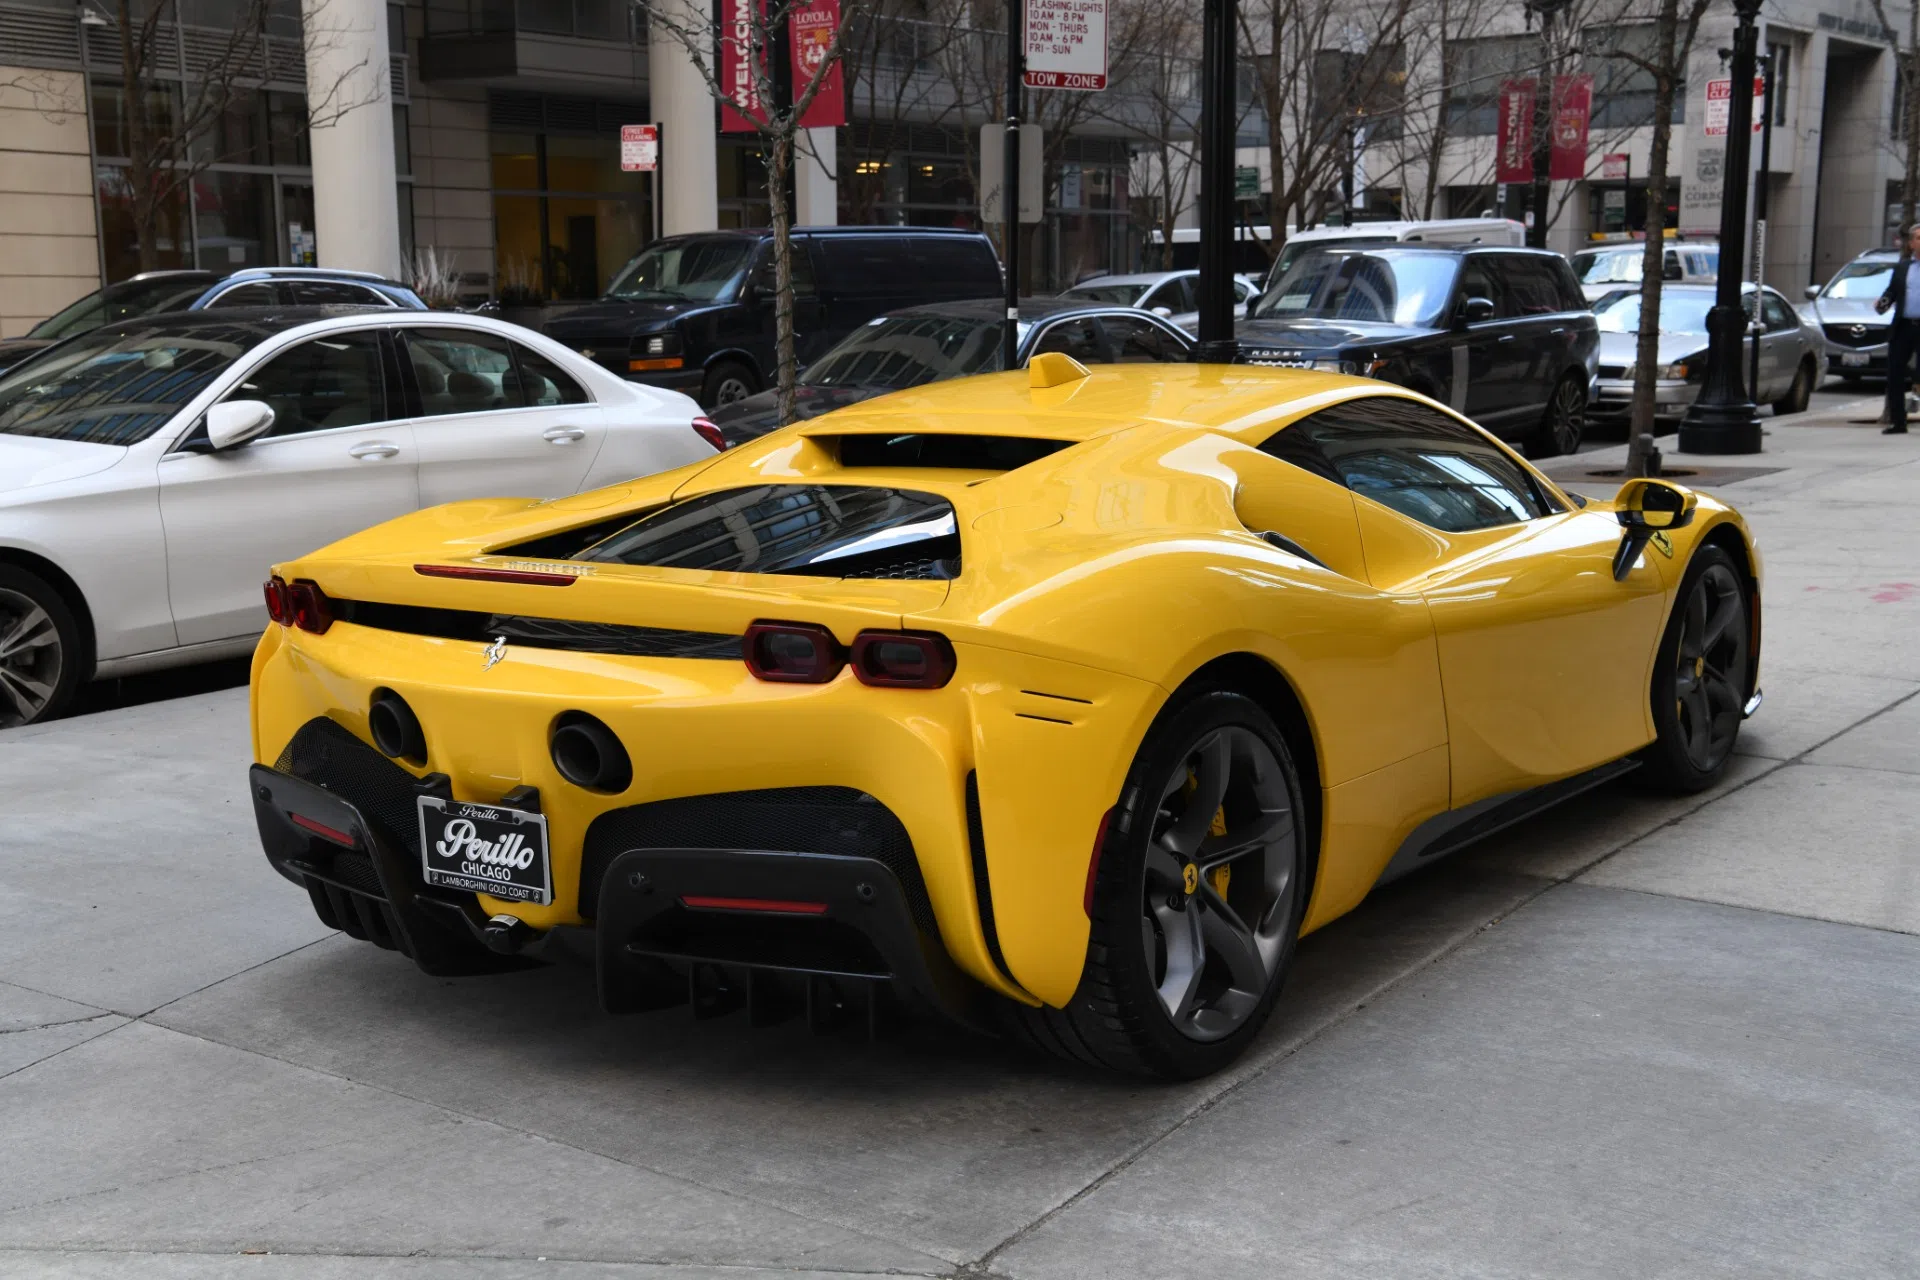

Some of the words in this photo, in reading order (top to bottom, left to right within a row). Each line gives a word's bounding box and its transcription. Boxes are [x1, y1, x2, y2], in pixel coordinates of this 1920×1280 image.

[1029, 0, 1072, 11] FLASHING
[1074, 3, 1103, 13] LIGHTS
[796, 10, 834, 25] LOYOLA
[1030, 10, 1039, 19] 10
[1041, 11, 1054, 20] AM
[1063, 12, 1069, 21] 8
[1072, 13, 1084, 22] PM
[1029, 21, 1049, 31] MON
[1059, 23, 1089, 34] THURS
[1029, 32, 1038, 41] 10
[1040, 33, 1053, 42] AM
[1062, 35, 1068, 44] 6
[1070, 35, 1083, 44] PM
[1029, 43, 1044, 53] FRI
[1052, 45, 1071, 55] SUN
[1029, 72, 1057, 86] TOW
[1064, 74, 1099, 88] ZONE
[459, 804, 500, 821] Perillo
[436, 819, 534, 870] Perillo
[461, 861, 511, 881] CHICAGO
[441, 875, 487, 891] LAMBORGHINI
[488, 882, 507, 895] GOLD
[509, 888, 529, 899] COAST
